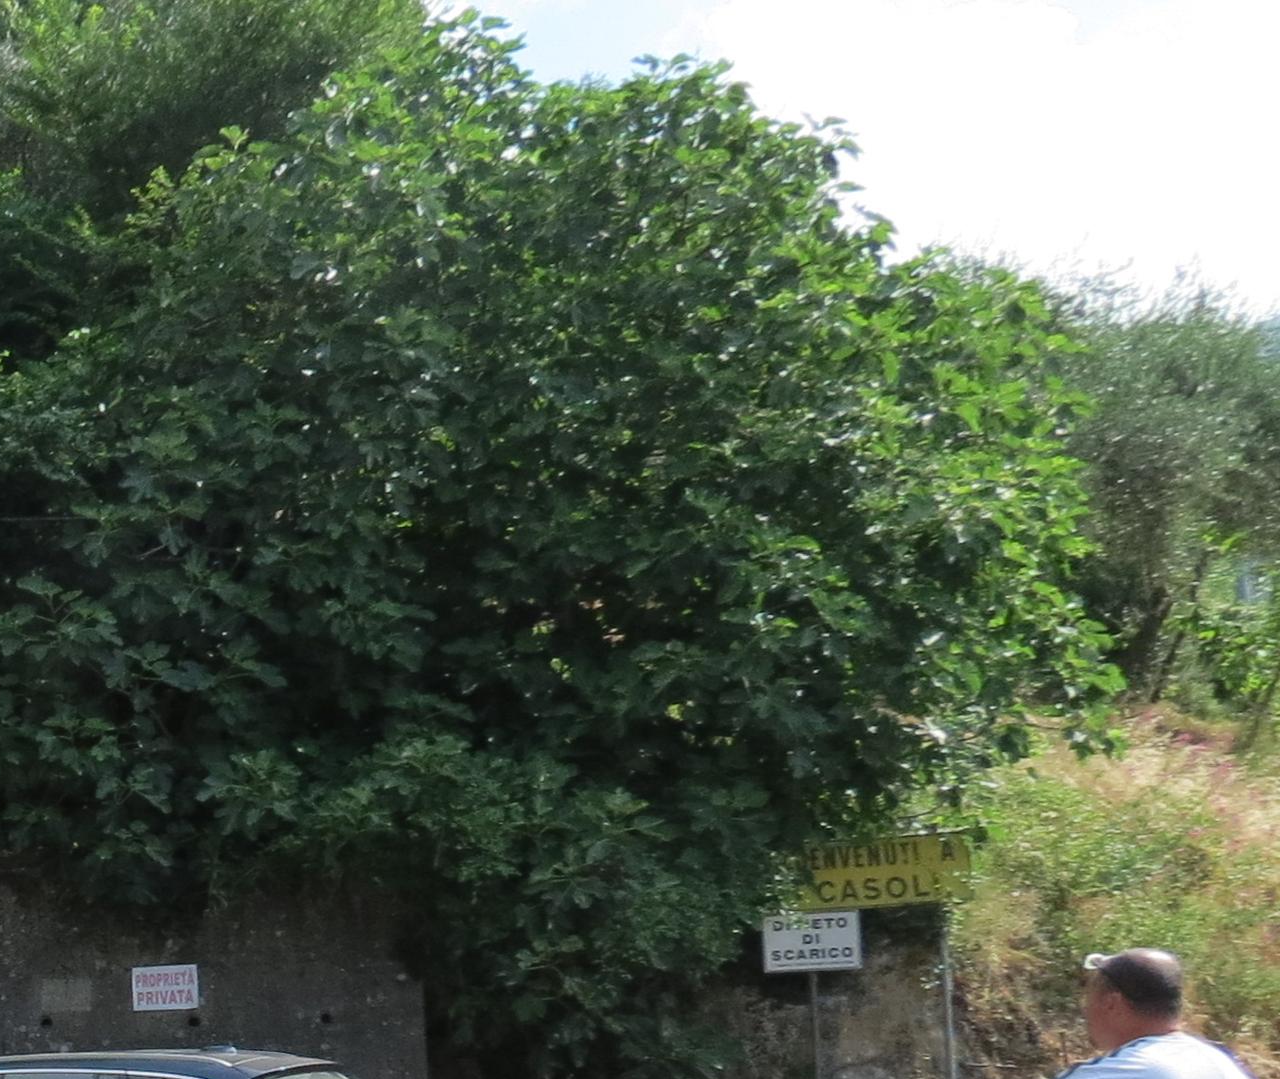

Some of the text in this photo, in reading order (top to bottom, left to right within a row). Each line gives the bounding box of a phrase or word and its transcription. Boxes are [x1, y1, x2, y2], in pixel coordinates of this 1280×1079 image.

[805, 840, 921, 870] ENVENUTI
[772, 917, 848, 931] DIETO
[802, 933, 821, 945] DI
[771, 947, 853, 961] SCARICO
[137, 989, 193, 1005] PRIVATA
